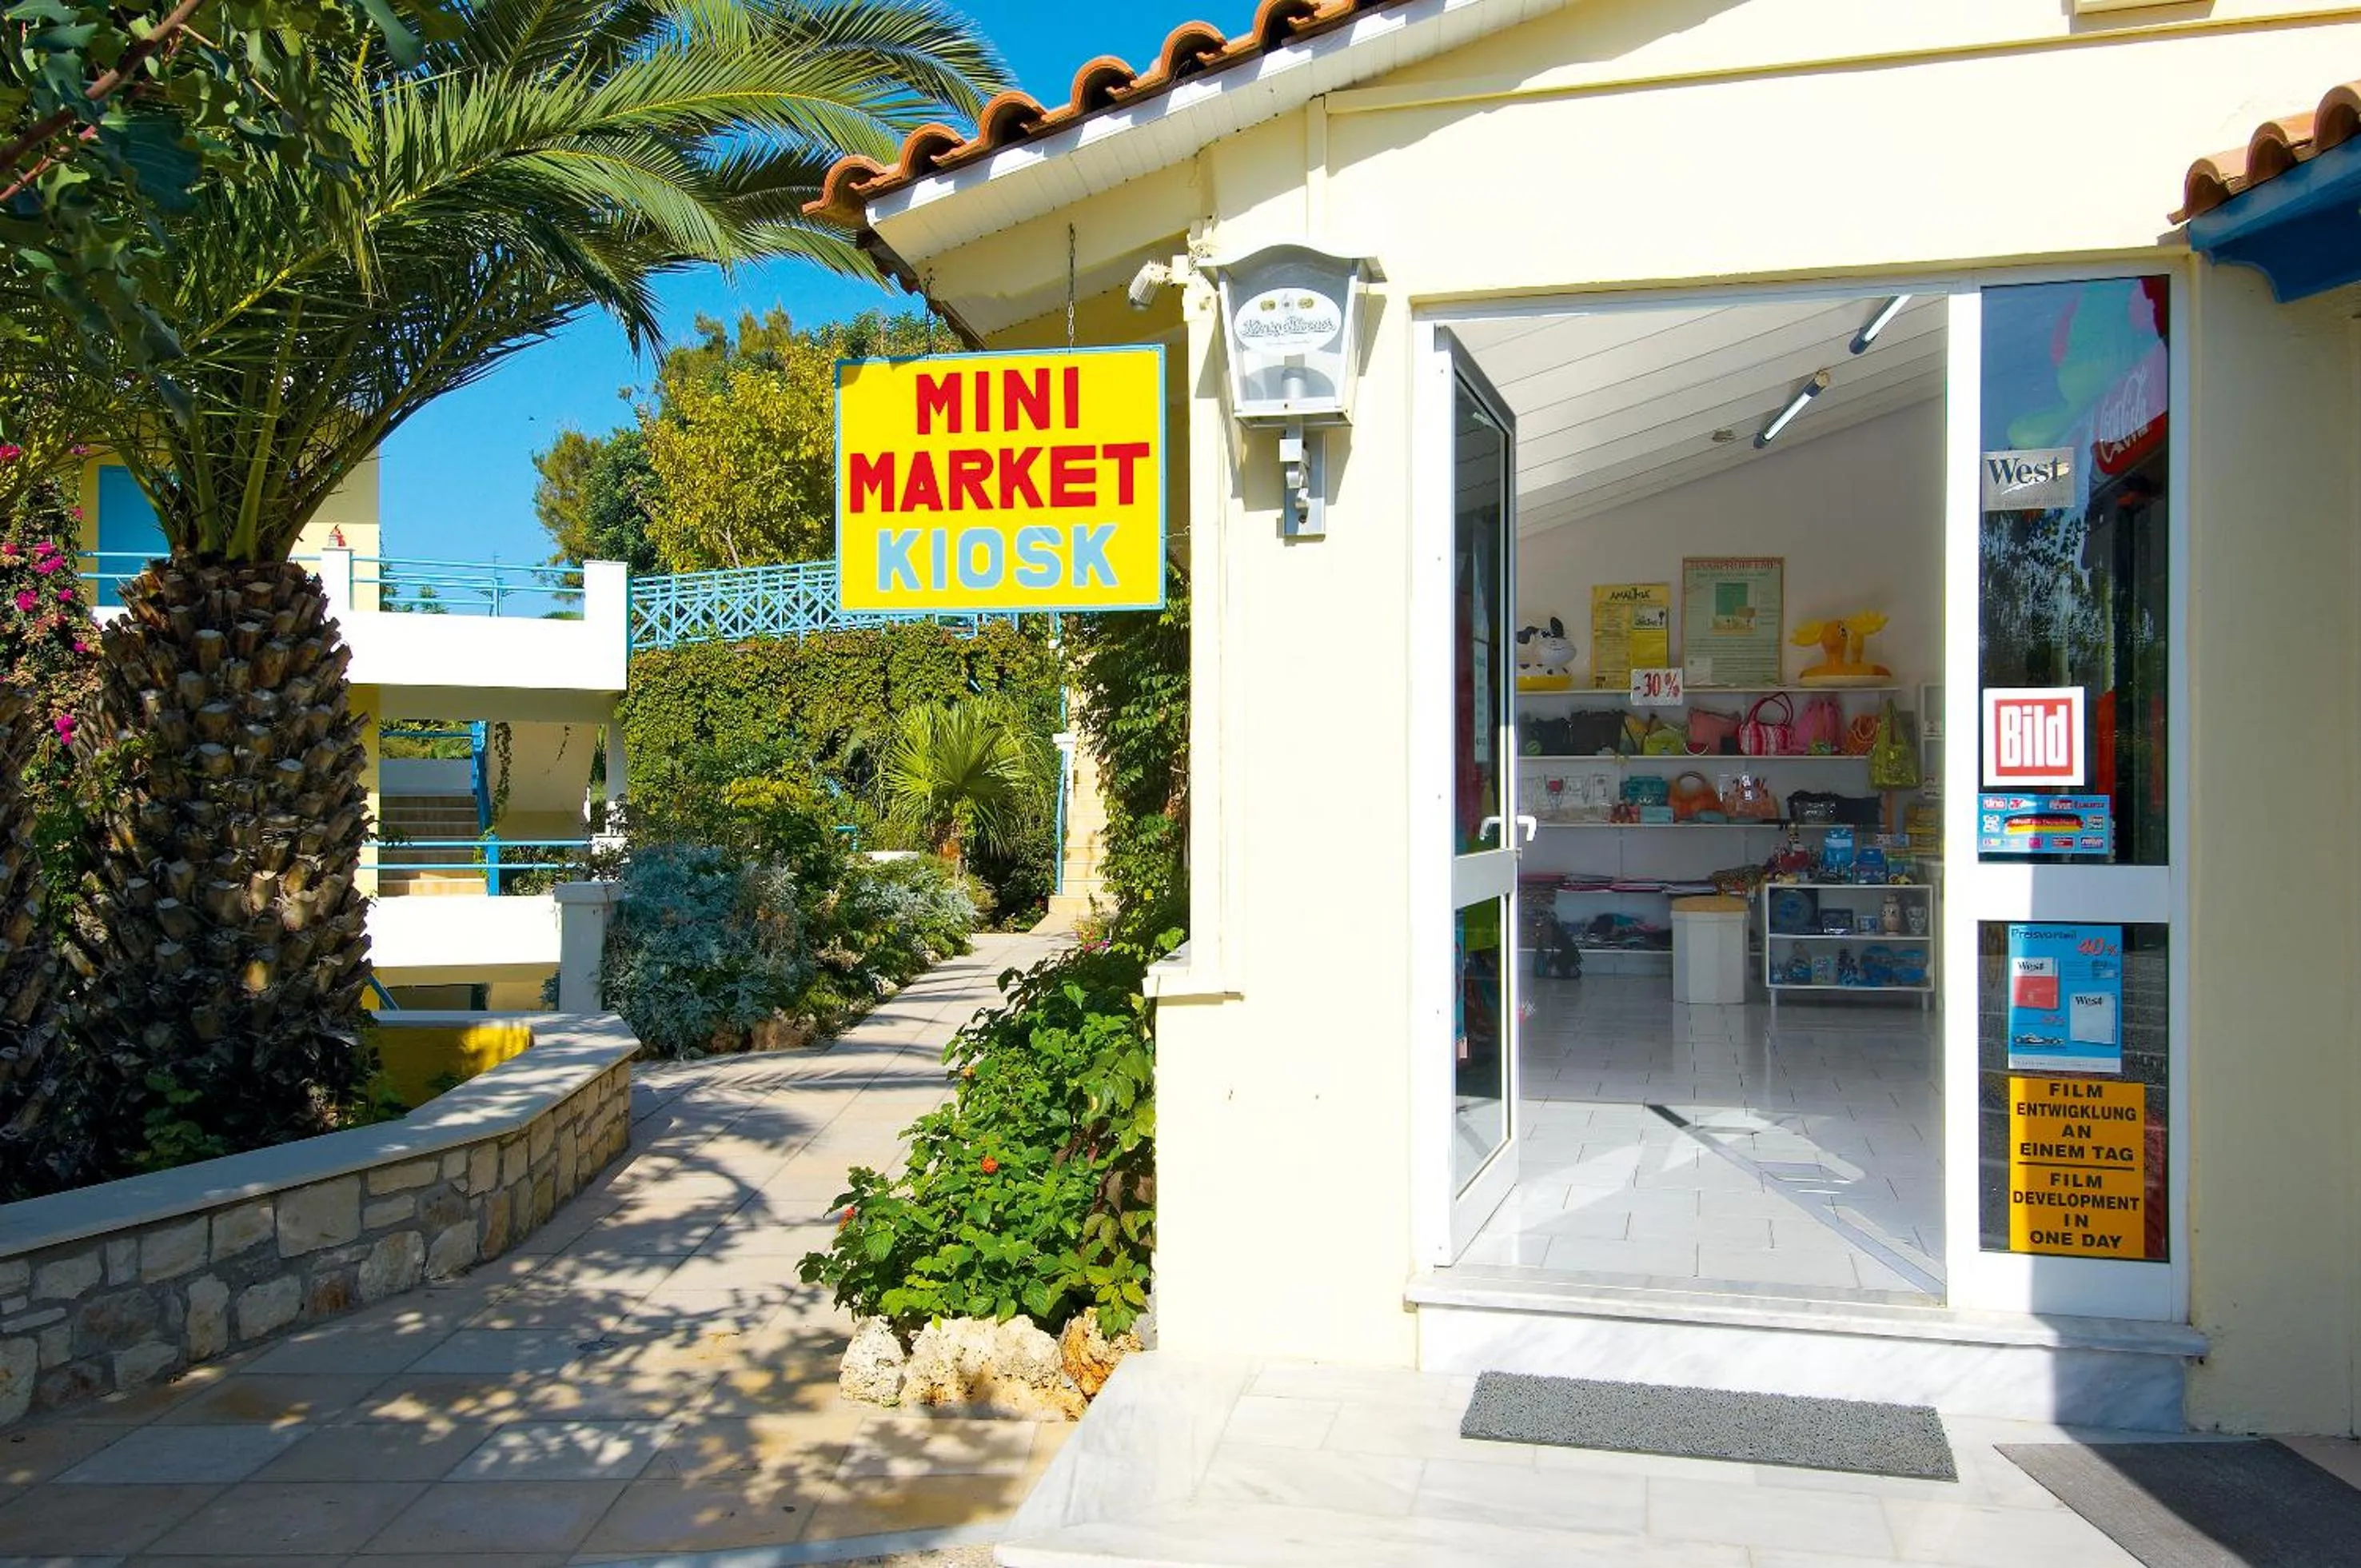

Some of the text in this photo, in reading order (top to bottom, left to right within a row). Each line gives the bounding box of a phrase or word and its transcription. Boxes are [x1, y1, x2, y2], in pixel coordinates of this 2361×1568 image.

[916, 366, 1079, 435] MINI
[850, 442, 1150, 513] MARKET
[1986, 457, 2061, 485] West
[877, 522, 1119, 592] KIOSK
[2000, 704, 2068, 768] Bild
[2018, 962, 2045, 972] West
[2075, 995, 2104, 1006] West
[2049, 1083, 2103, 1098] FILM
[2061, 1125, 2091, 1139] AN
[2020, 1143, 2134, 1161] EINEM TAG
[2050, 1173, 2102, 1188] FILM
[2013, 1191, 2140, 1211] DEVELOPMENT
[2064, 1214, 2088, 1227] IN
[2029, 1231, 2122, 1249] ONE DAY
